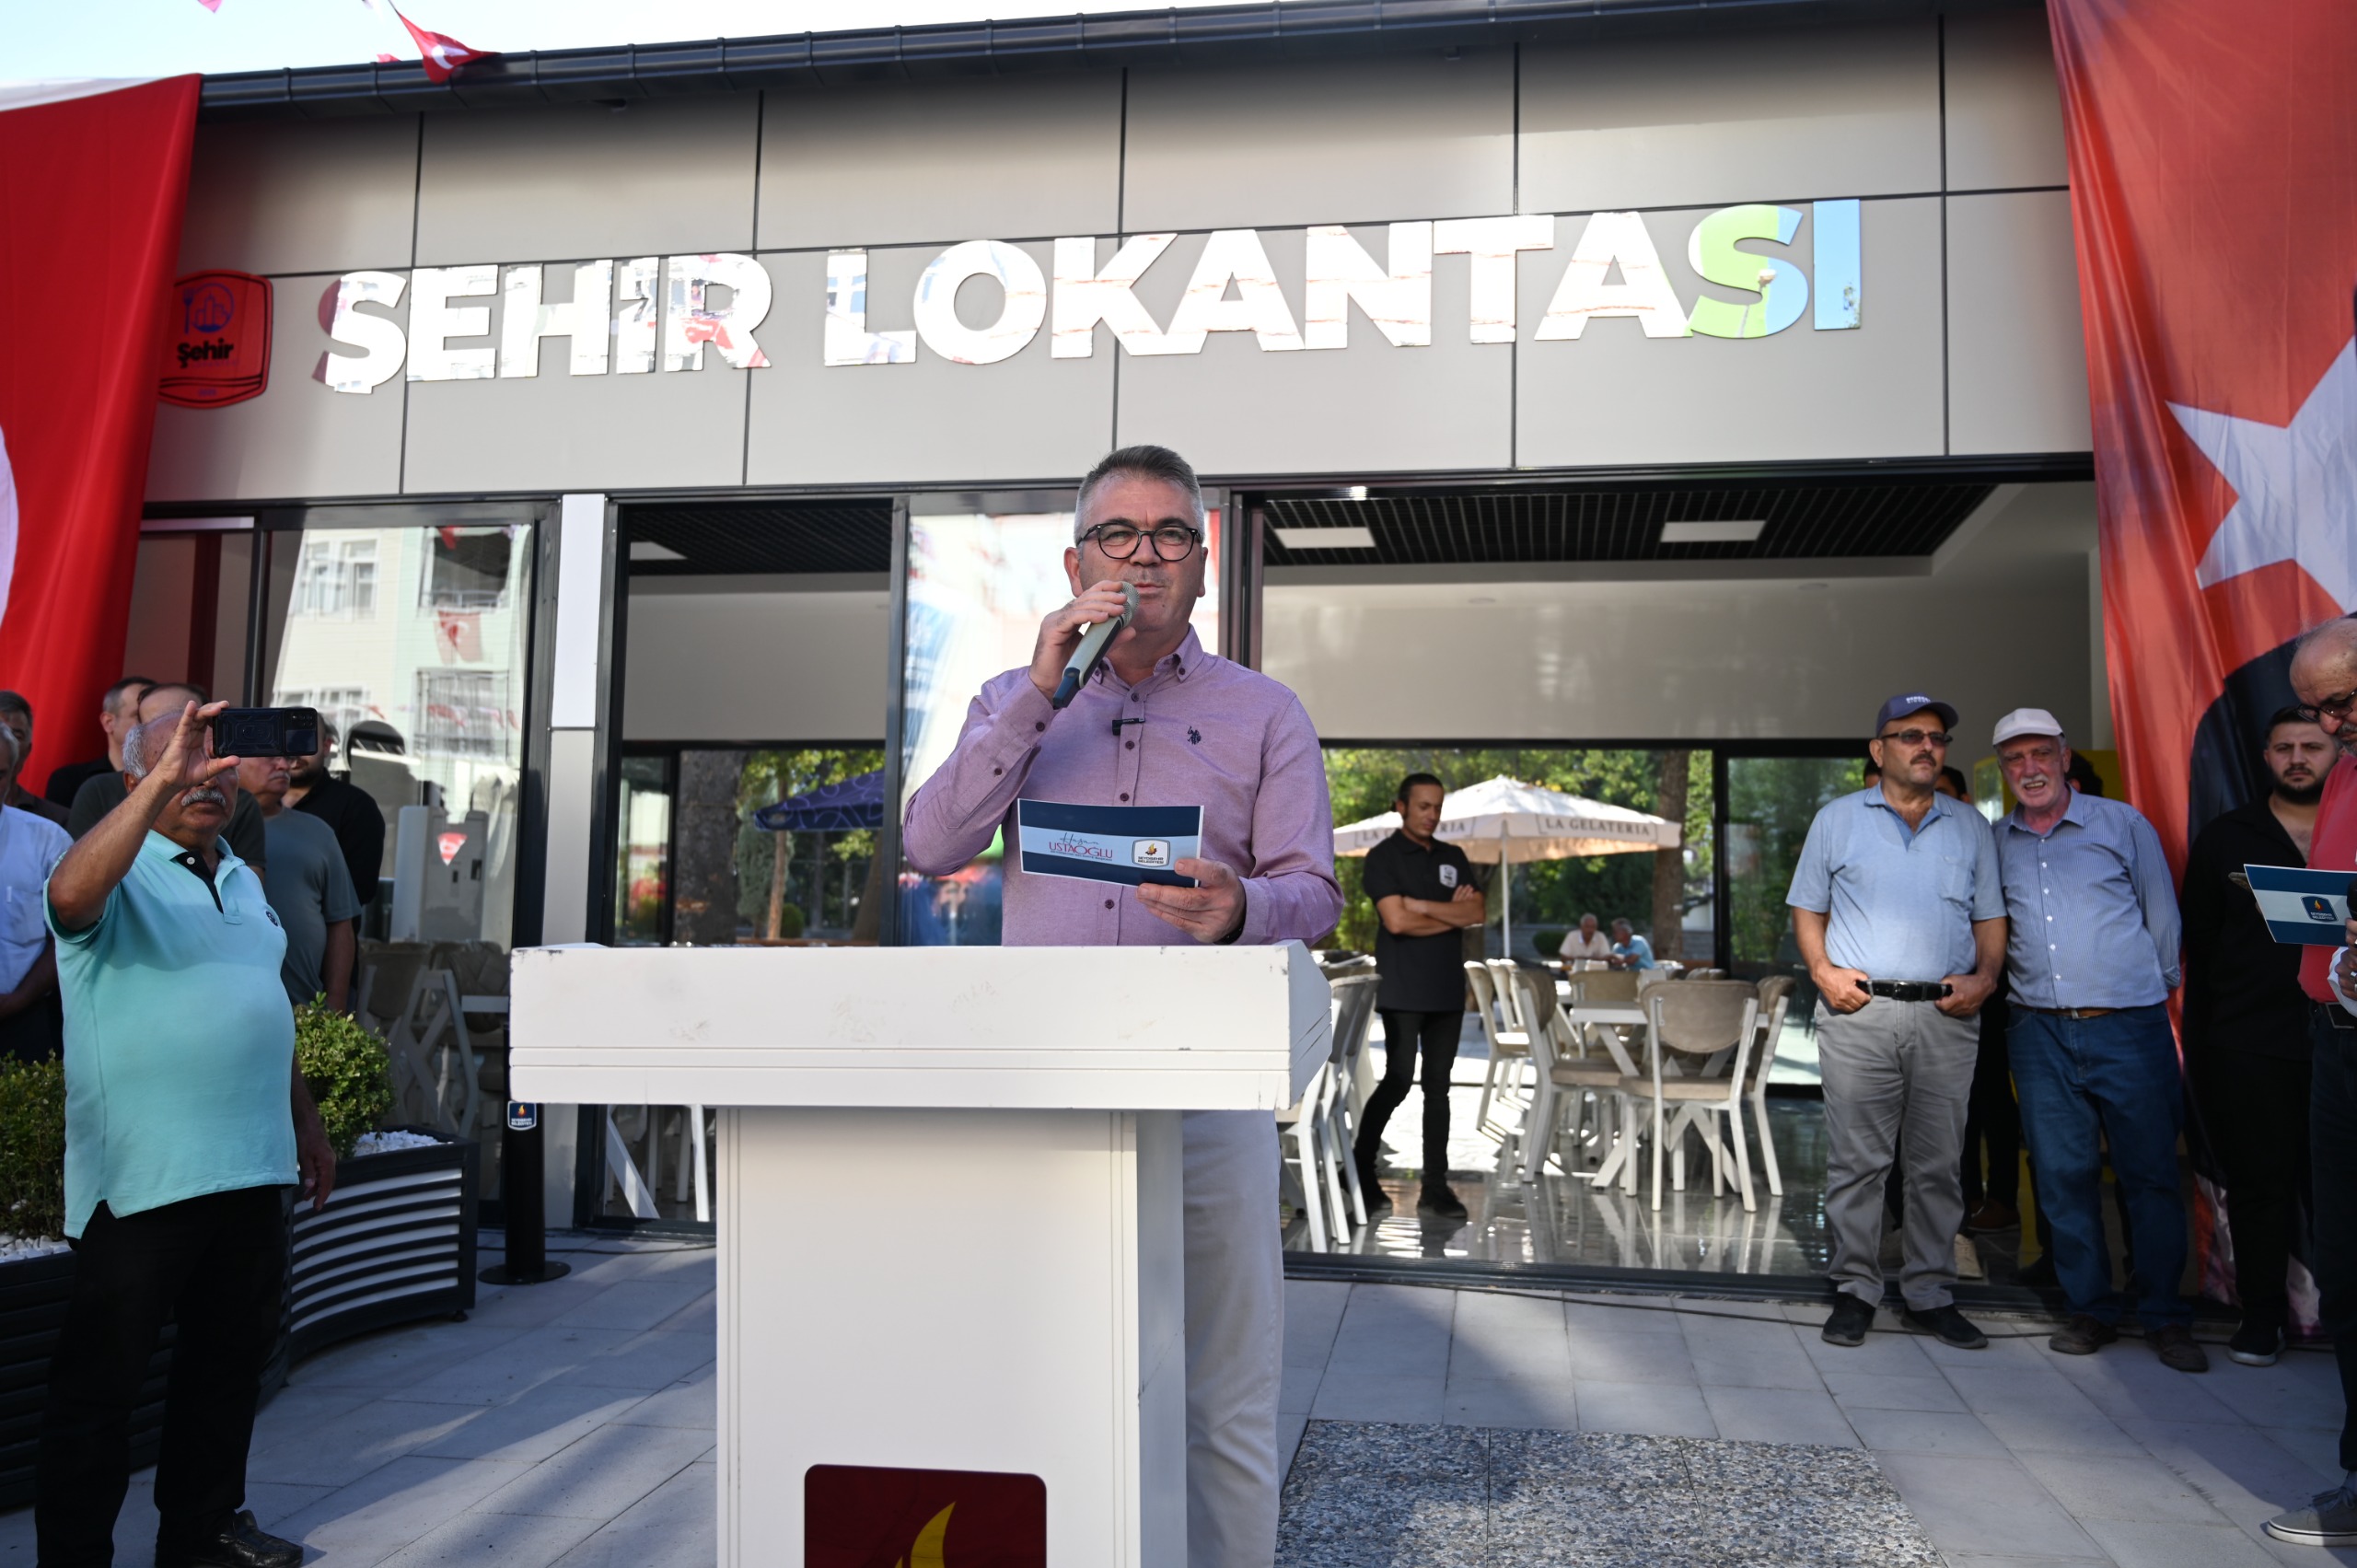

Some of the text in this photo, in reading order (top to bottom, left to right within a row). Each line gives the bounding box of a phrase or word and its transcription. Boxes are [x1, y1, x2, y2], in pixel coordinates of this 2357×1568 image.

[824, 198, 1862, 367] LOKANTASI
[177, 338, 234, 368] Şehir
[1546, 818, 1650, 836] LA GELATERIA
[1049, 842, 1113, 858] USTAOĞLU
